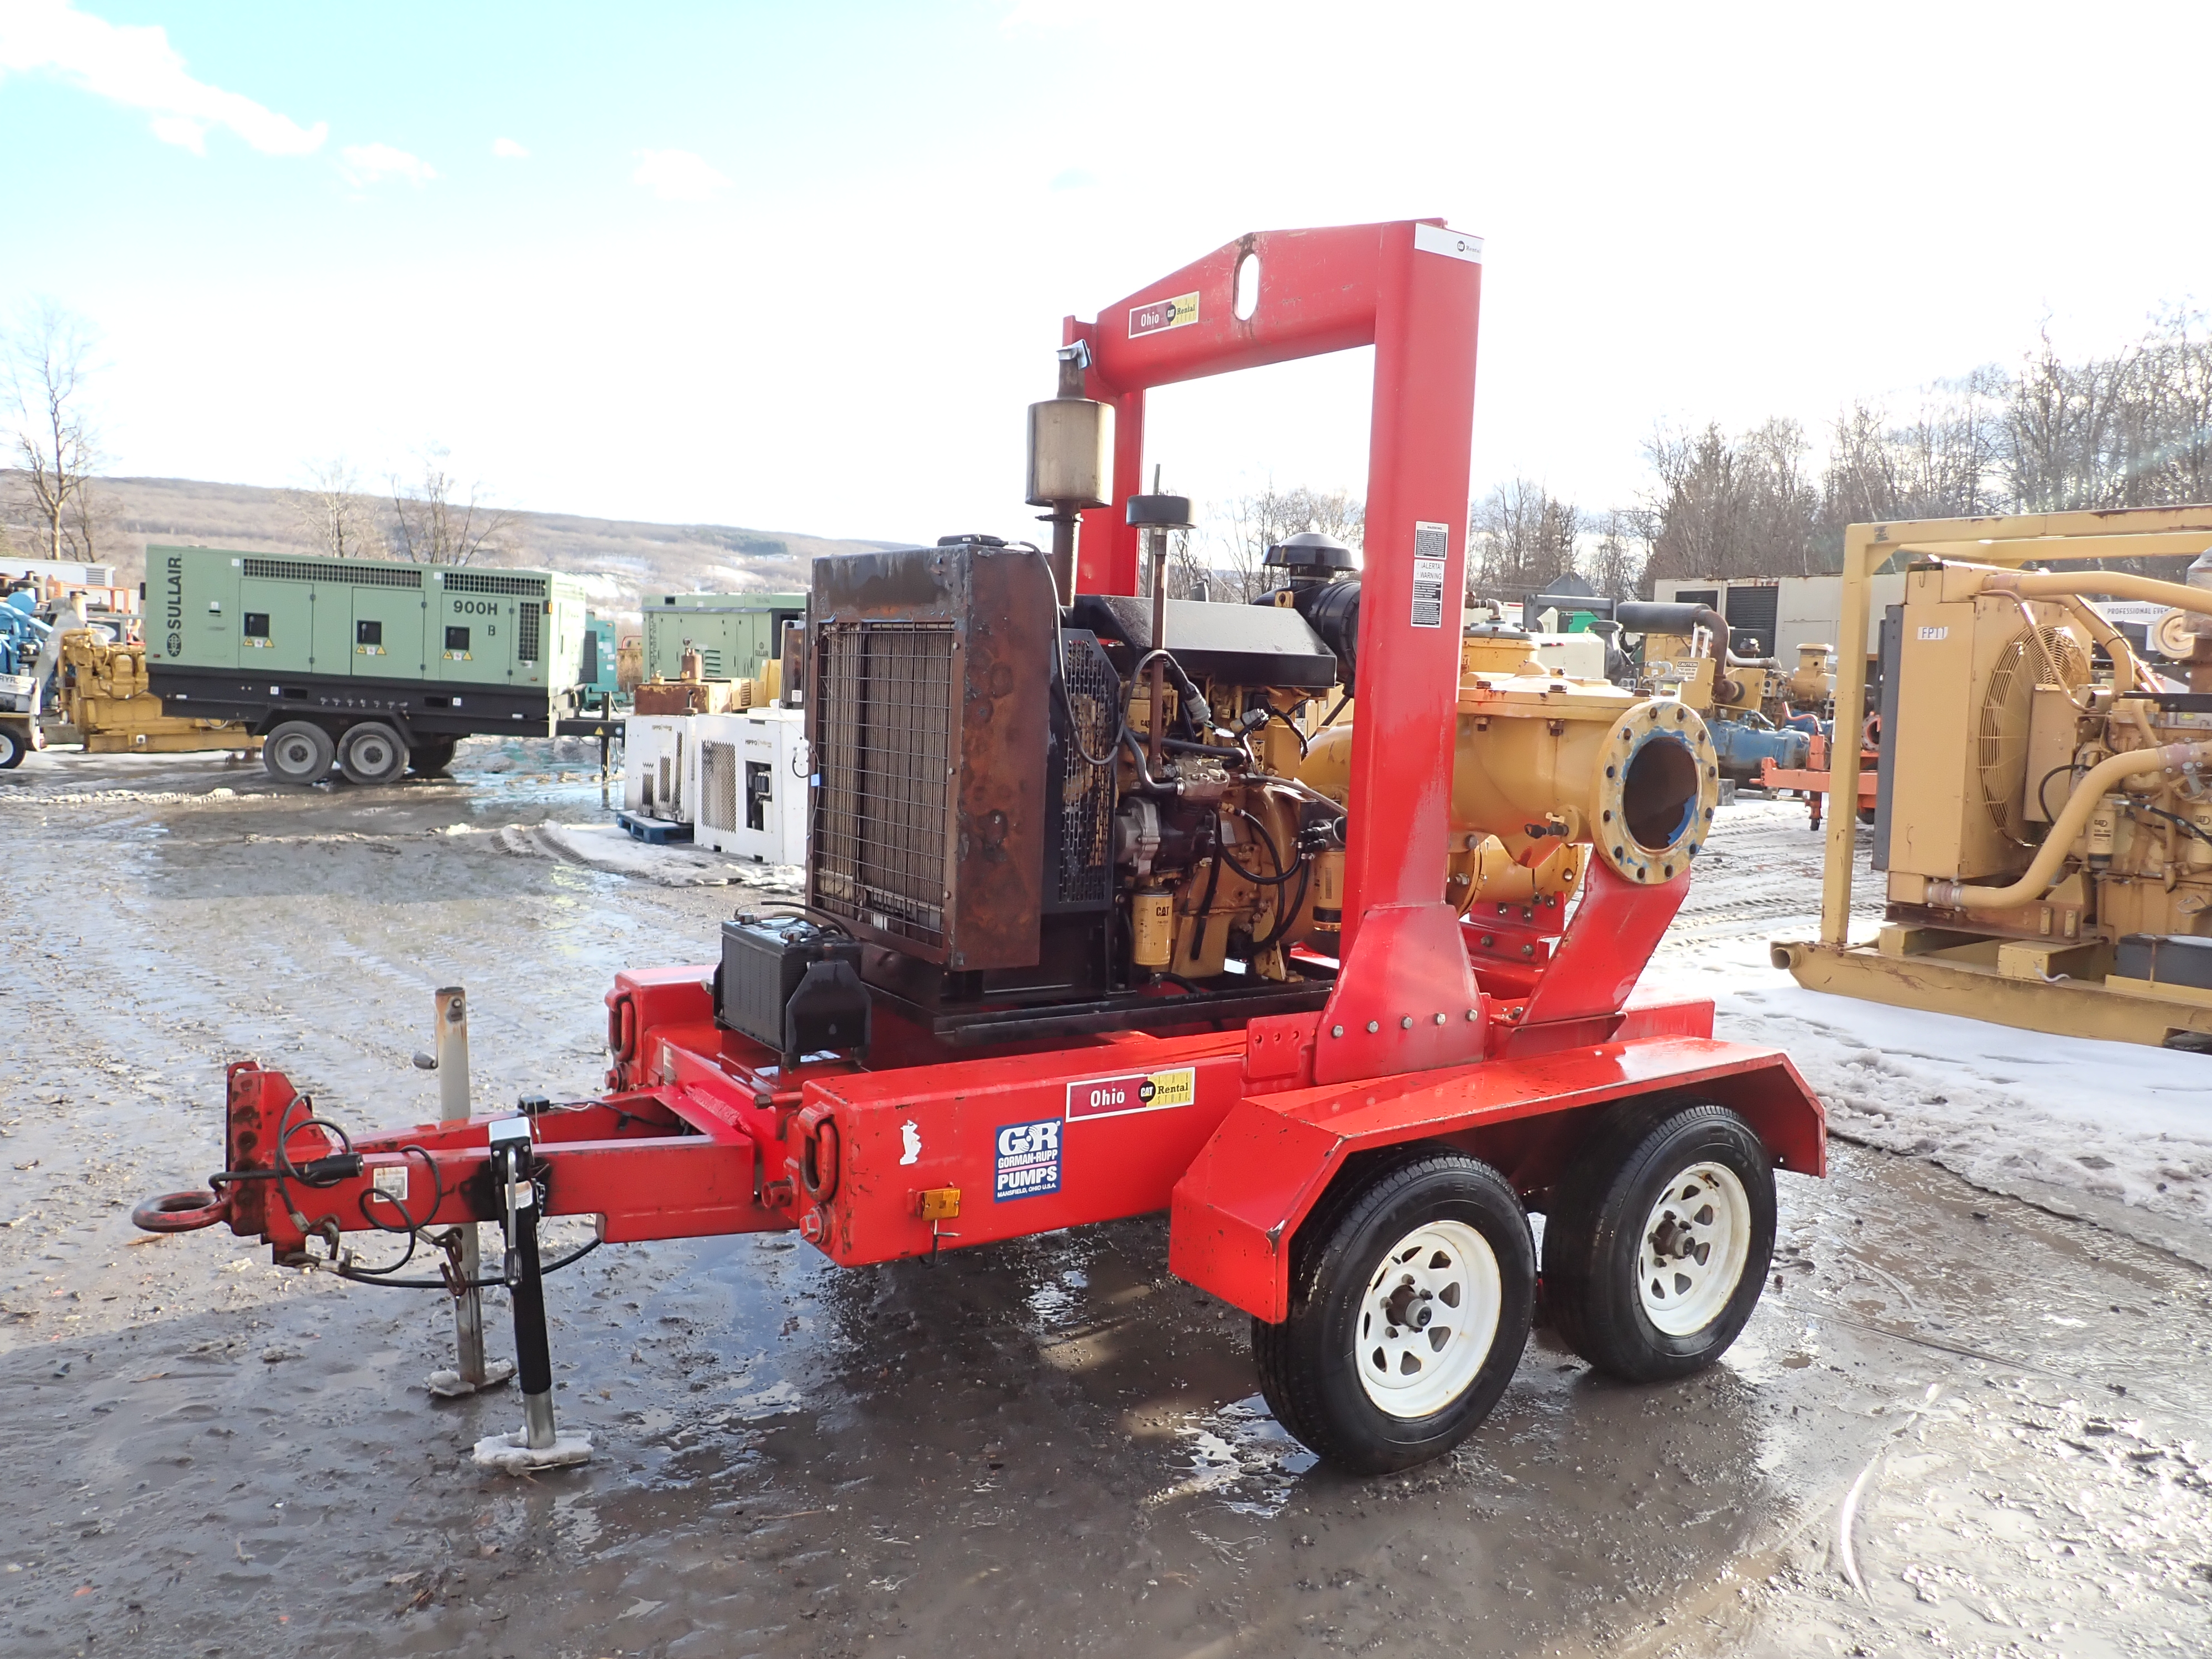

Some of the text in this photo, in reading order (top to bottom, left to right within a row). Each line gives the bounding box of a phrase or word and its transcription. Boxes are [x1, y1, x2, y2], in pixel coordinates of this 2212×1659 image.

[1466, 245, 1481, 254] Rental
[1141, 311, 1159, 327] Ohio
[1177, 304, 1195, 315] Rental
[1420, 571, 1442, 580] WARNING
[168, 557, 181, 629] SULLAIR
[453, 600, 498, 615] 900H
[488, 625, 495, 636] B
[1156, 906, 1170, 916] CAT
[1090, 1082, 1188, 1107] Ohio CAT Rental
[997, 1166, 1057, 1190] PUMPS
[997, 1187, 1027, 1198] MANSFIELD,
